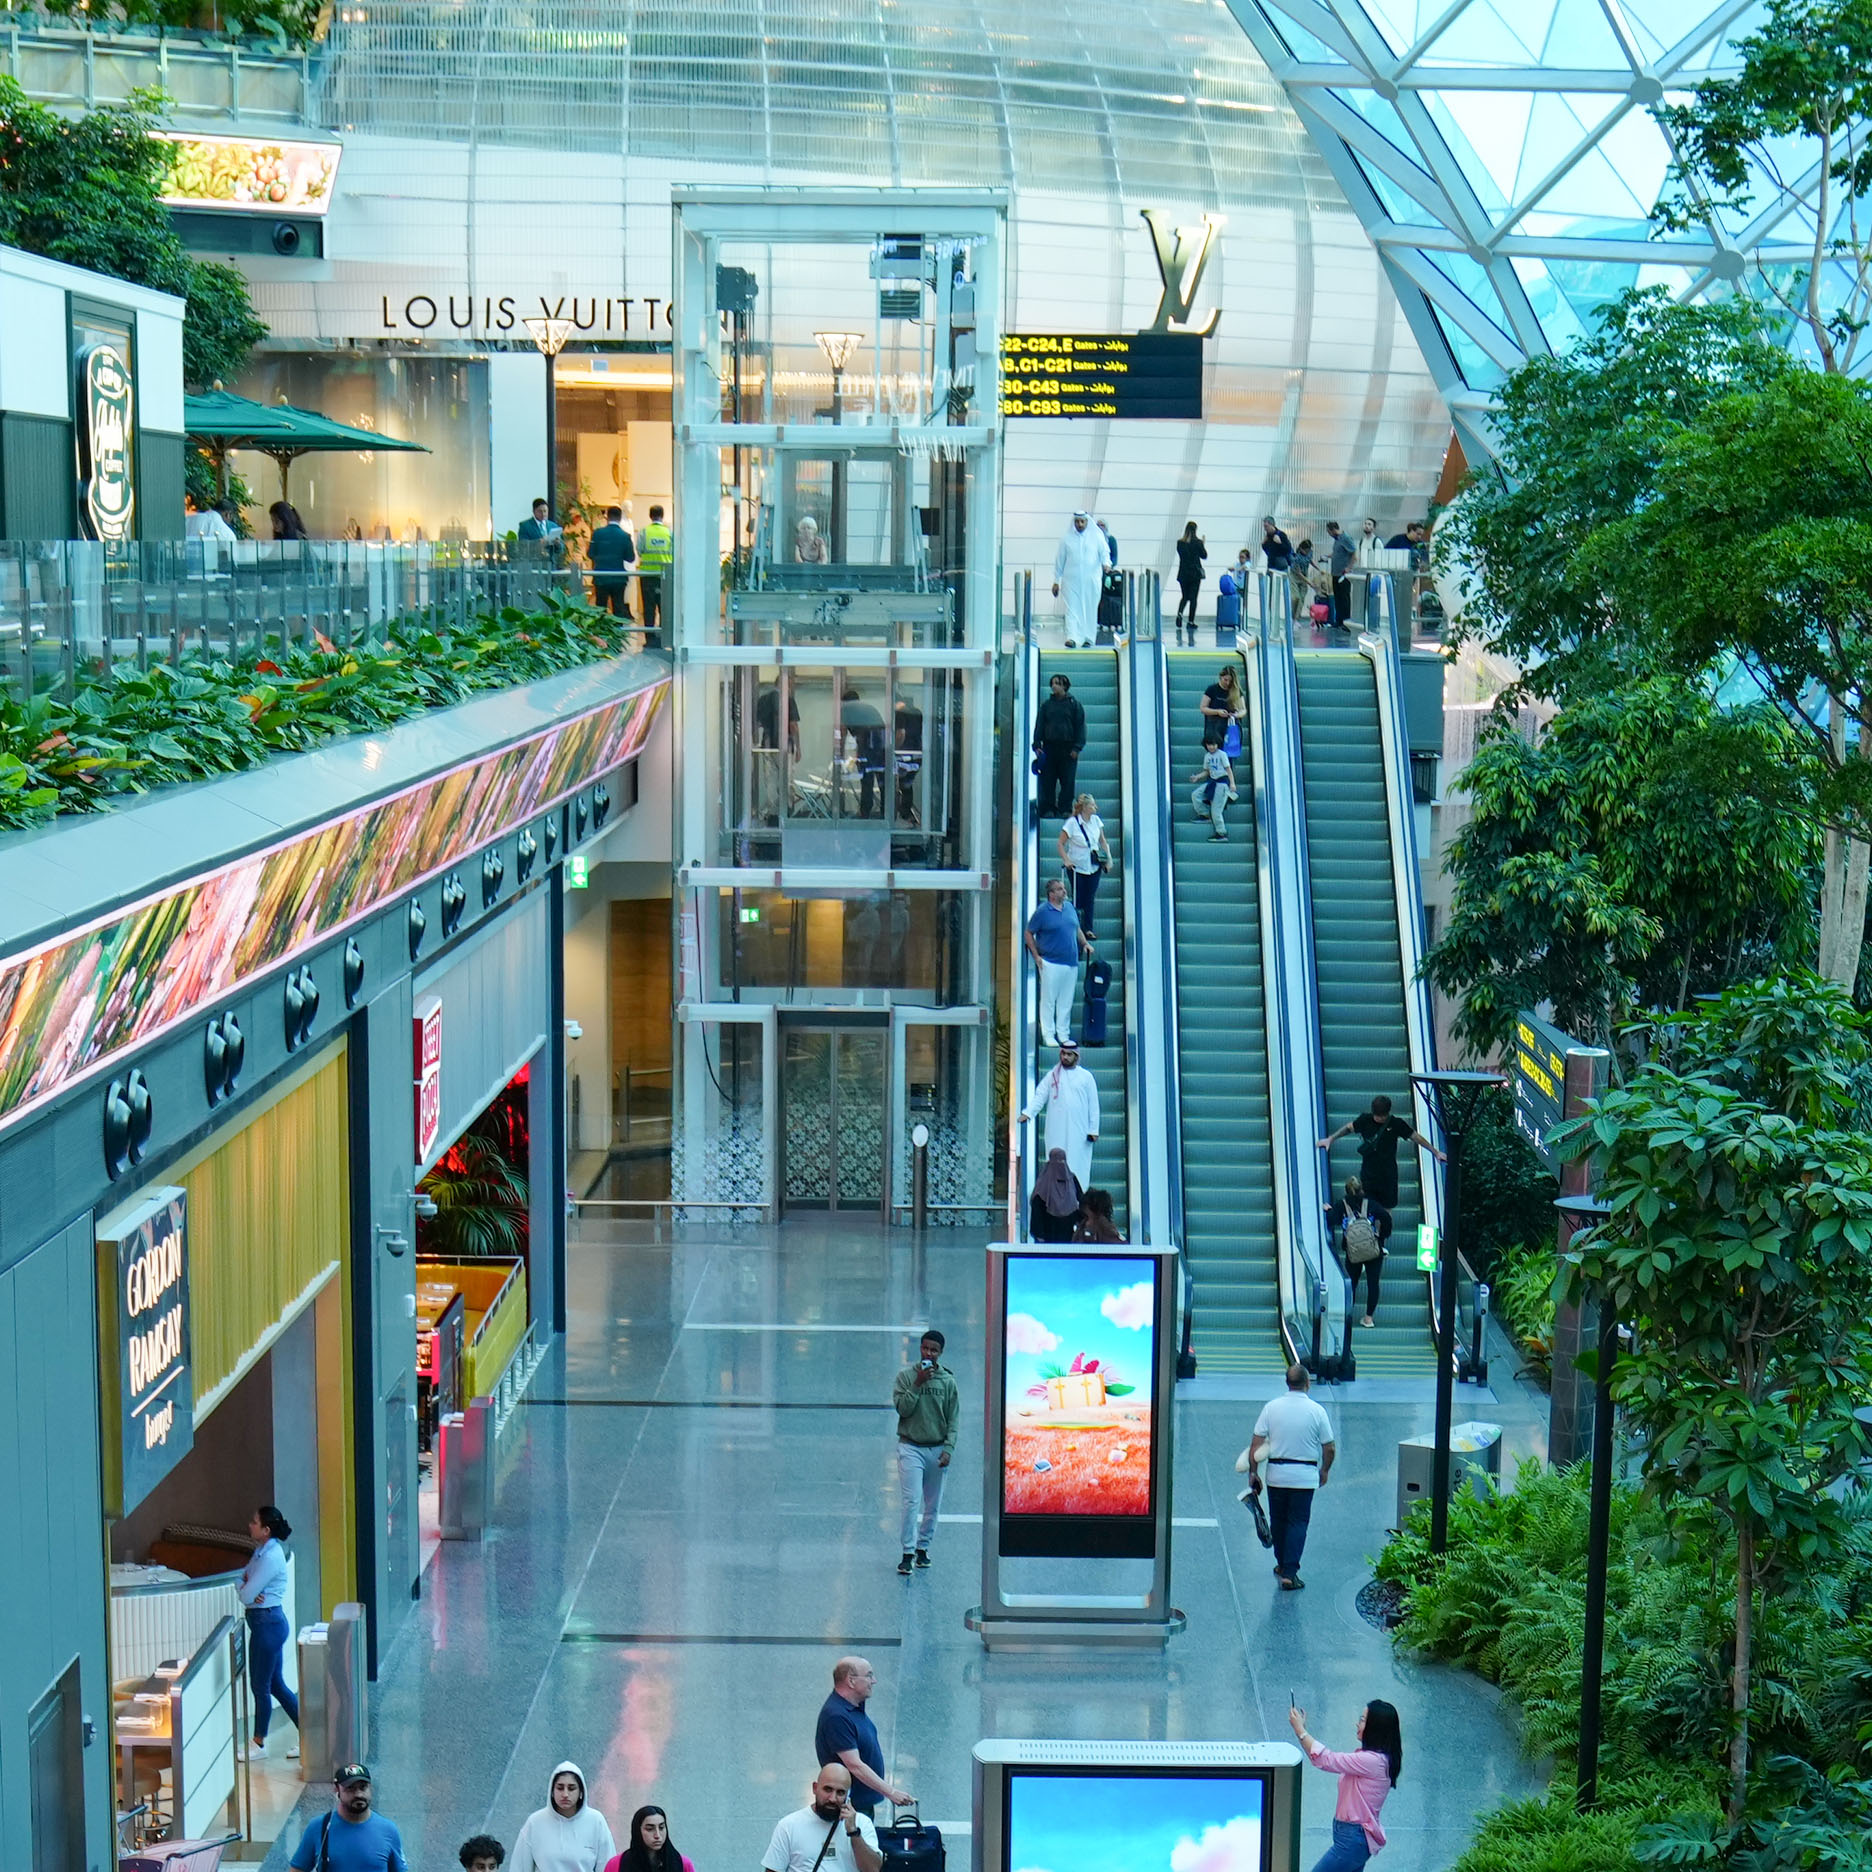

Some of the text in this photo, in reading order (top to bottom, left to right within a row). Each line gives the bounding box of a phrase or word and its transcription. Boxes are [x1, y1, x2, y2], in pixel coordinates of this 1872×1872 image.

[383, 295, 730, 332] LOUIS VUITT
[126, 1228, 182, 1319] GORDON
[129, 1303, 183, 1397] RAMSAY
